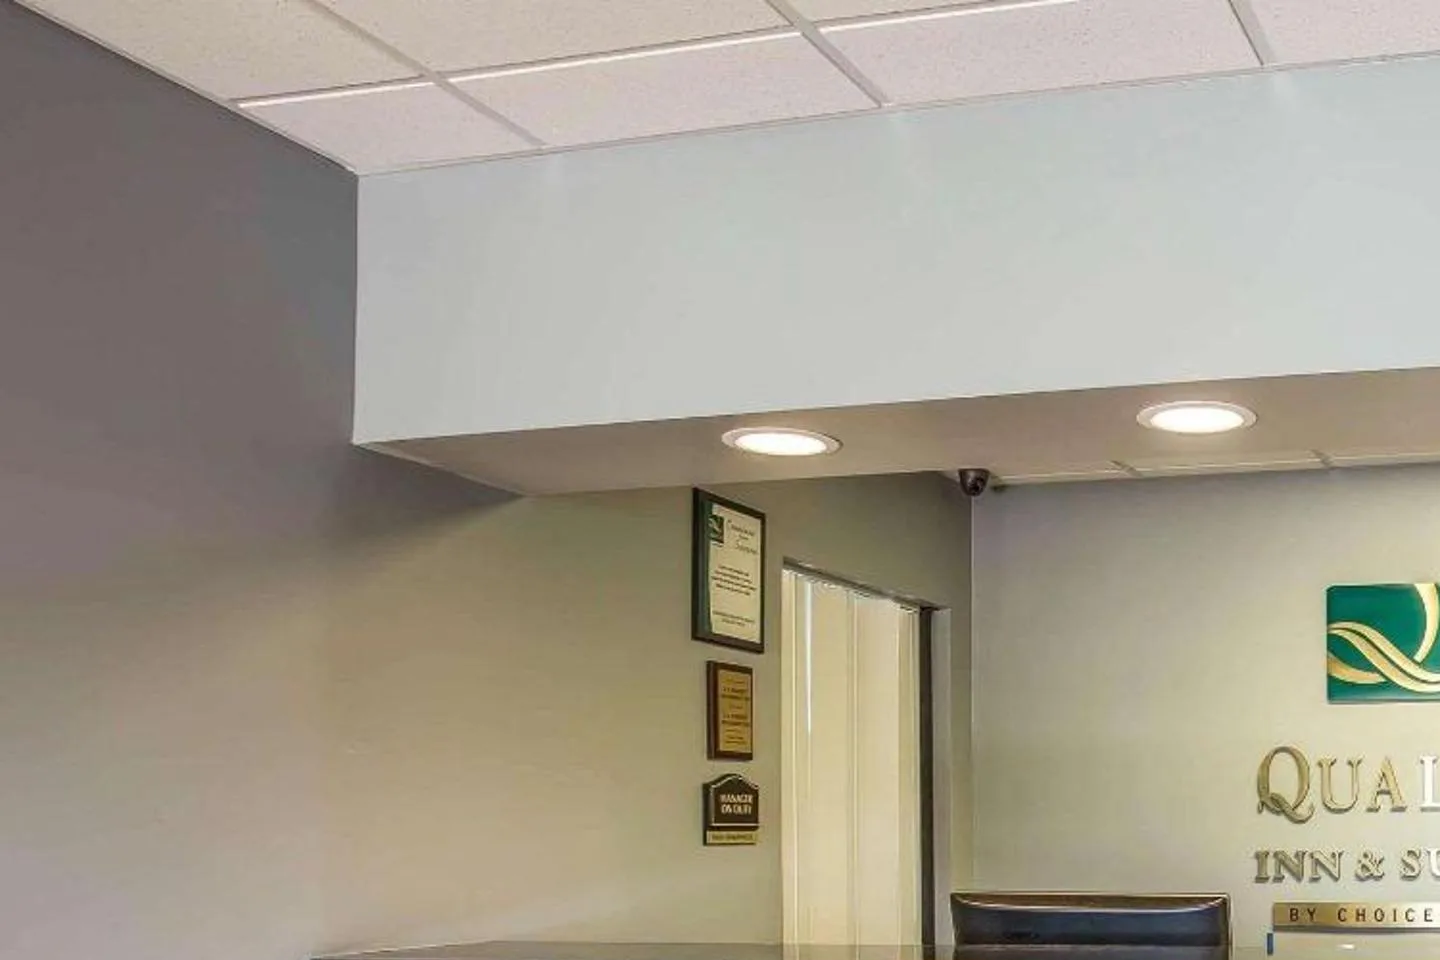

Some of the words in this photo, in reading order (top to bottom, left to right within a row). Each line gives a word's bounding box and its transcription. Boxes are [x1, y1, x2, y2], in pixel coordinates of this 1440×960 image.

[1254, 849, 1344, 883] INN
[1355, 849, 1386, 882] &
[1289, 907, 1317, 923] BY
[1337, 907, 1434, 923] CHOICE
